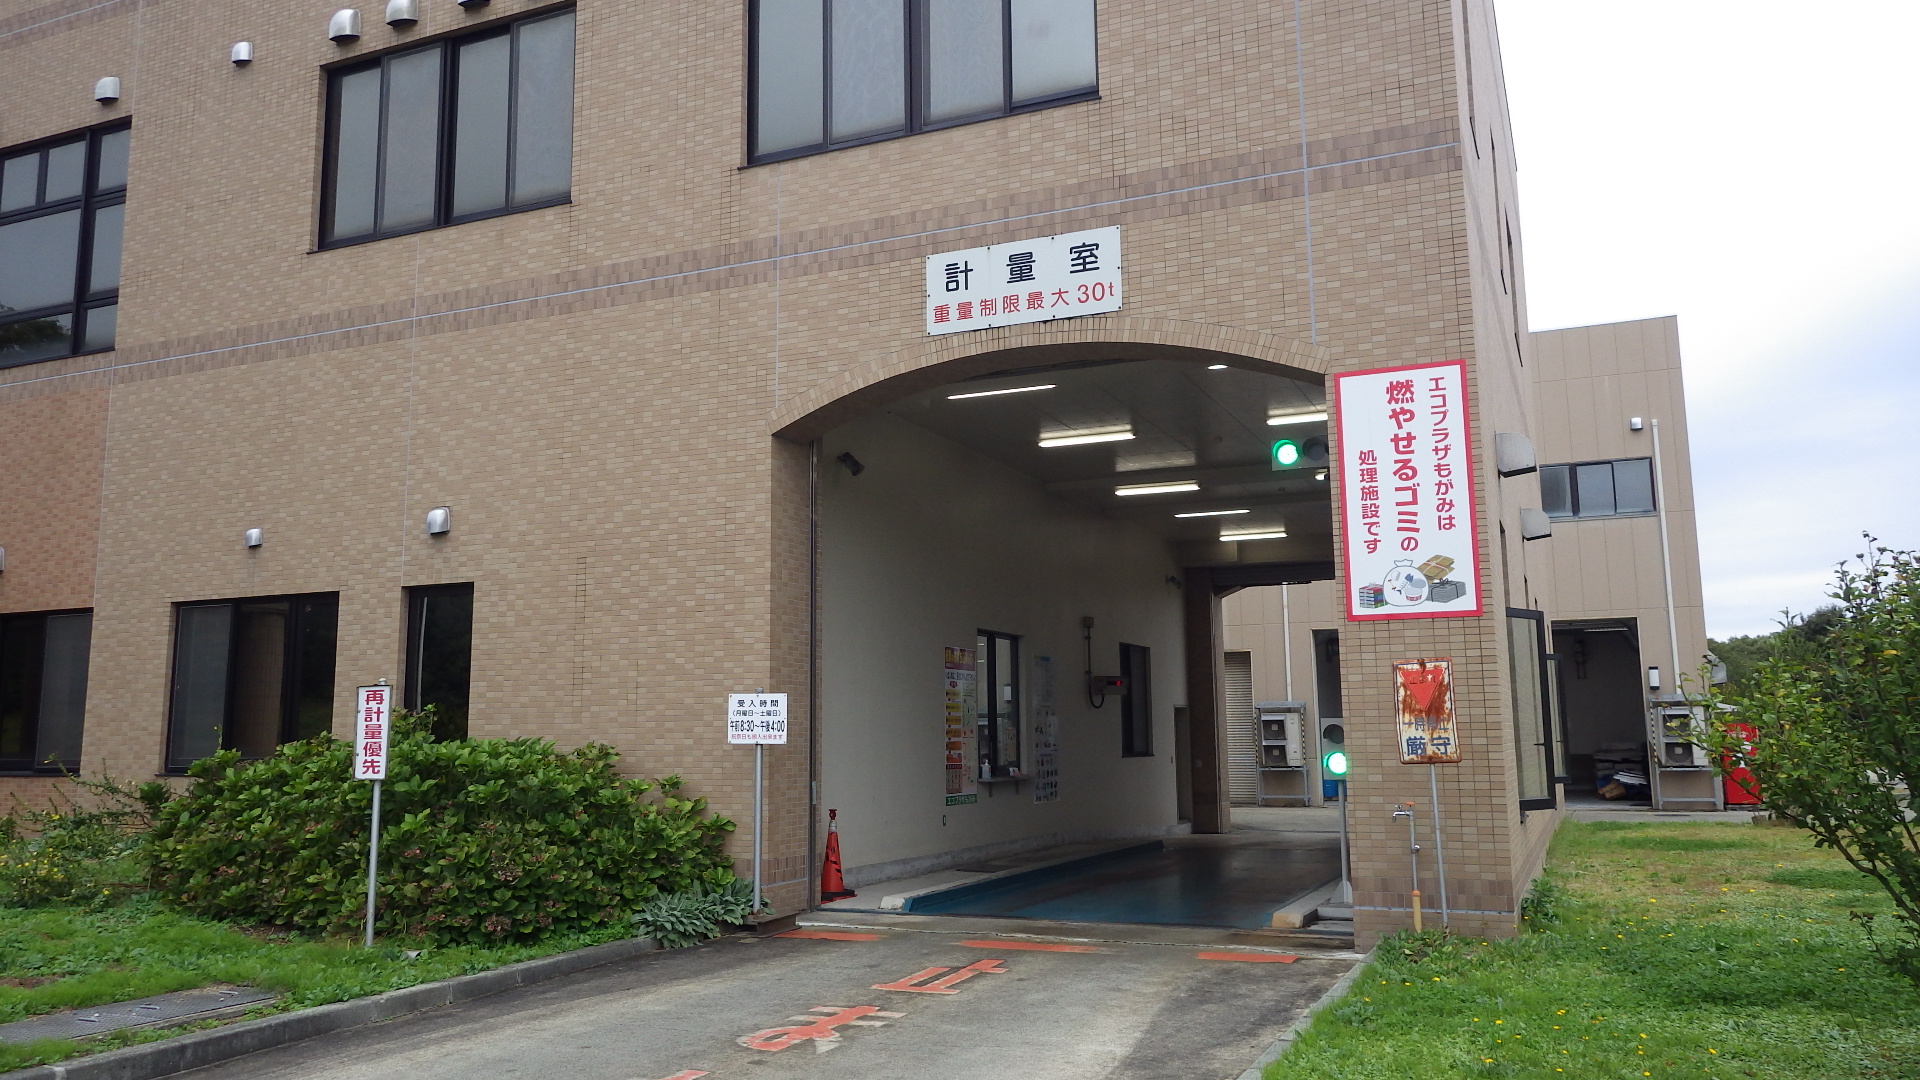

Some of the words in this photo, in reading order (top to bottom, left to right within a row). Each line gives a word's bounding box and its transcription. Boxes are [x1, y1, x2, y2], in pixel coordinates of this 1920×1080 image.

[945, 242, 1100, 292] 計量室
[933, 282, 1114, 324] 重量制限最大30t
[1385, 379, 1420, 551] 燃やせるゴミの
[1428, 376, 1456, 531] エコプラザもがみは
[1358, 449, 1382, 554] 処理施設です
[362, 689, 385, 775] 再計量優先
[737, 699, 779, 708] 受入時間
[1406, 735, 1451, 756] 厳守
